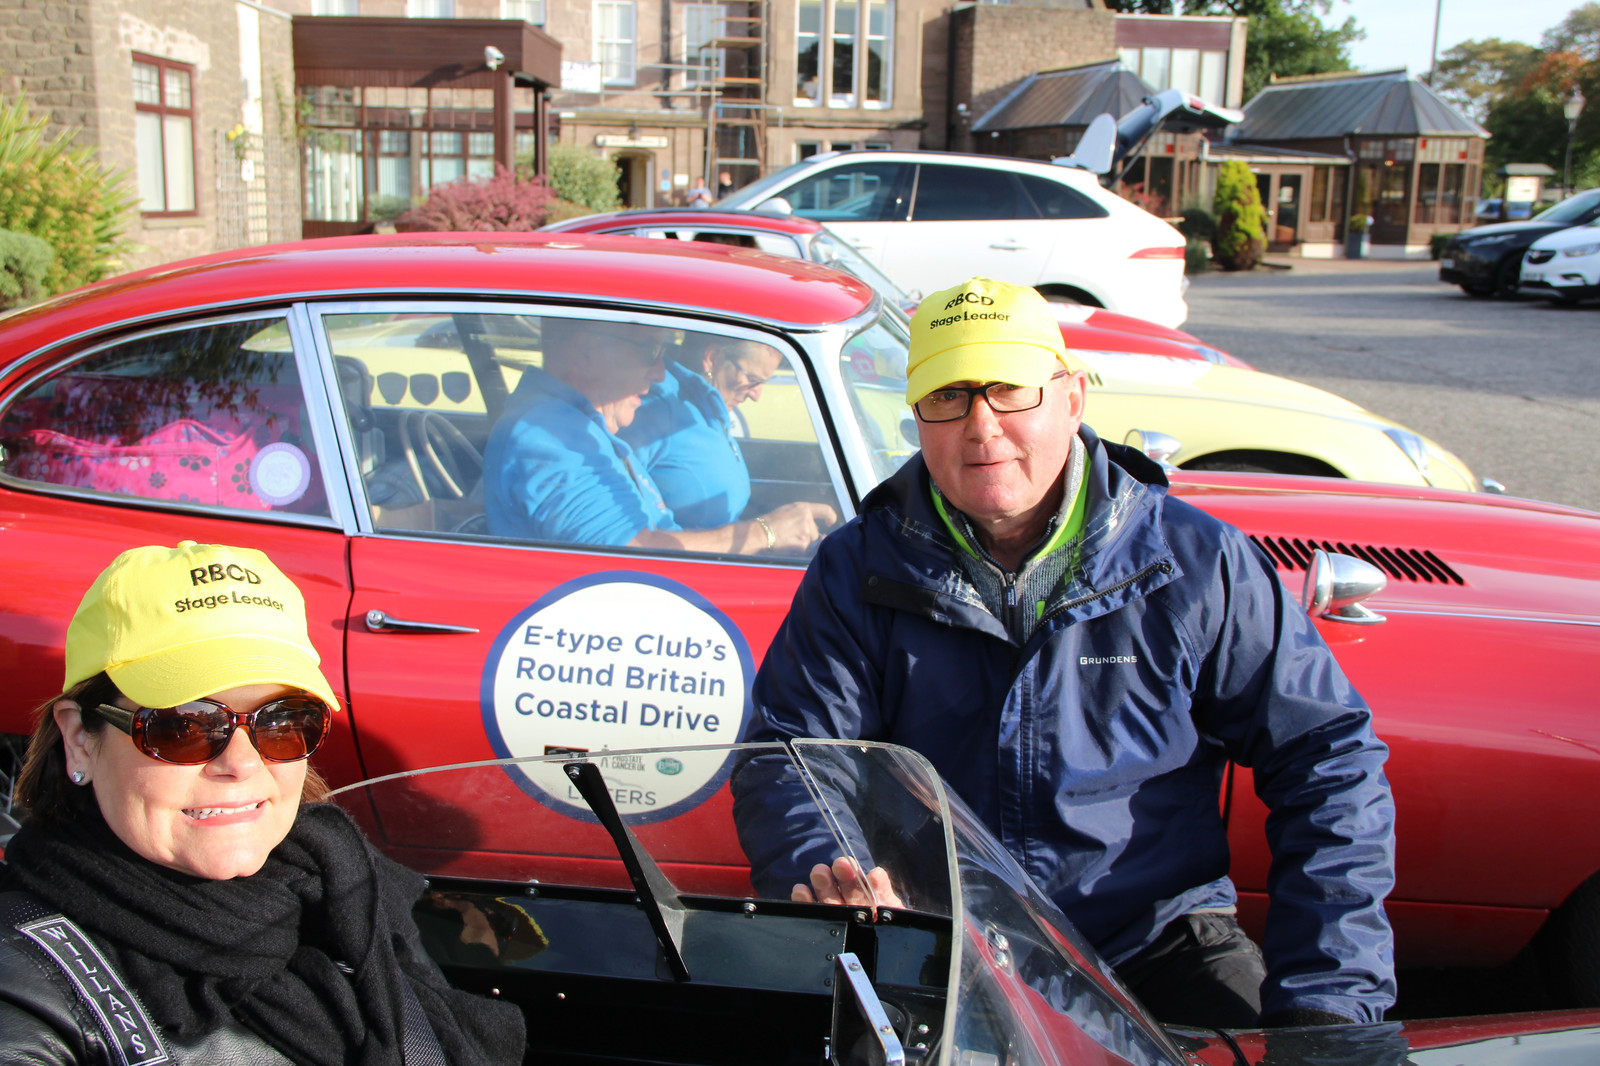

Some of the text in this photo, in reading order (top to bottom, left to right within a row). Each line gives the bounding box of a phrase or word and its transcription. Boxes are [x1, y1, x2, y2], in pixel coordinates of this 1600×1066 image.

[944, 292, 995, 310] RBCD
[930, 311, 1011, 330] Stage Leader
[190, 563, 262, 586] RBCD
[174, 591, 284, 613] Stage Leader
[524, 625, 727, 661] E-type Club’s
[1079, 655, 1138, 665] GRUNDENS
[516, 656, 725, 697] Round Britain
[514, 692, 720, 732] Coastal Drive
[41, 926, 147, 1055] WILLANS
